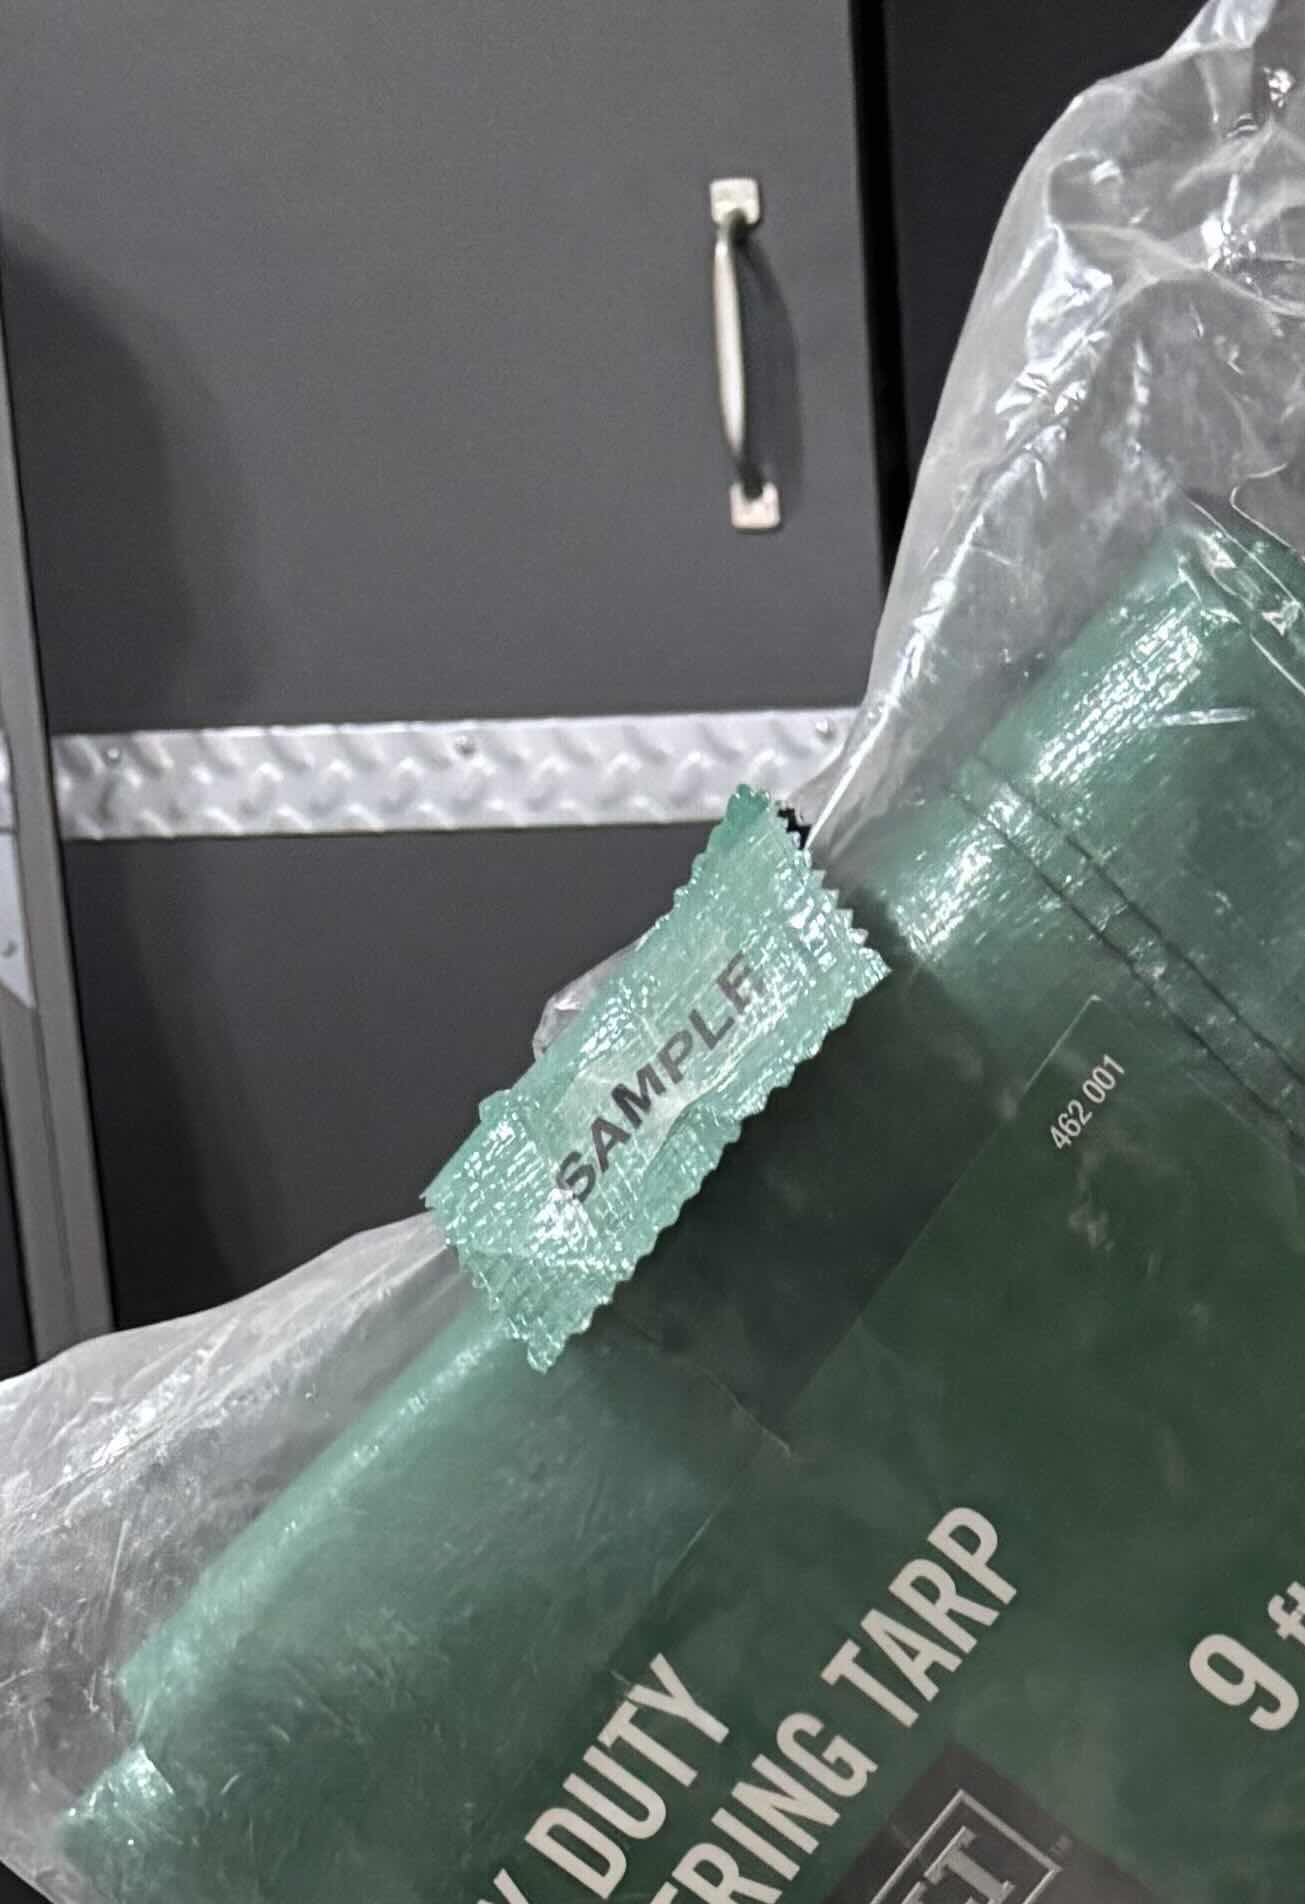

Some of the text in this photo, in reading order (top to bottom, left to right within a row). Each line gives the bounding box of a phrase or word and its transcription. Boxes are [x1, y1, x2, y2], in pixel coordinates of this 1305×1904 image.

[553, 952, 766, 1206] SAMPLE
[1049, 1055, 1127, 1151] 462 001
[822, 1506, 1016, 1728] TARP
[1190, 1634, 1299, 1731] 9
[524, 1654, 729, 1899] DUTY
